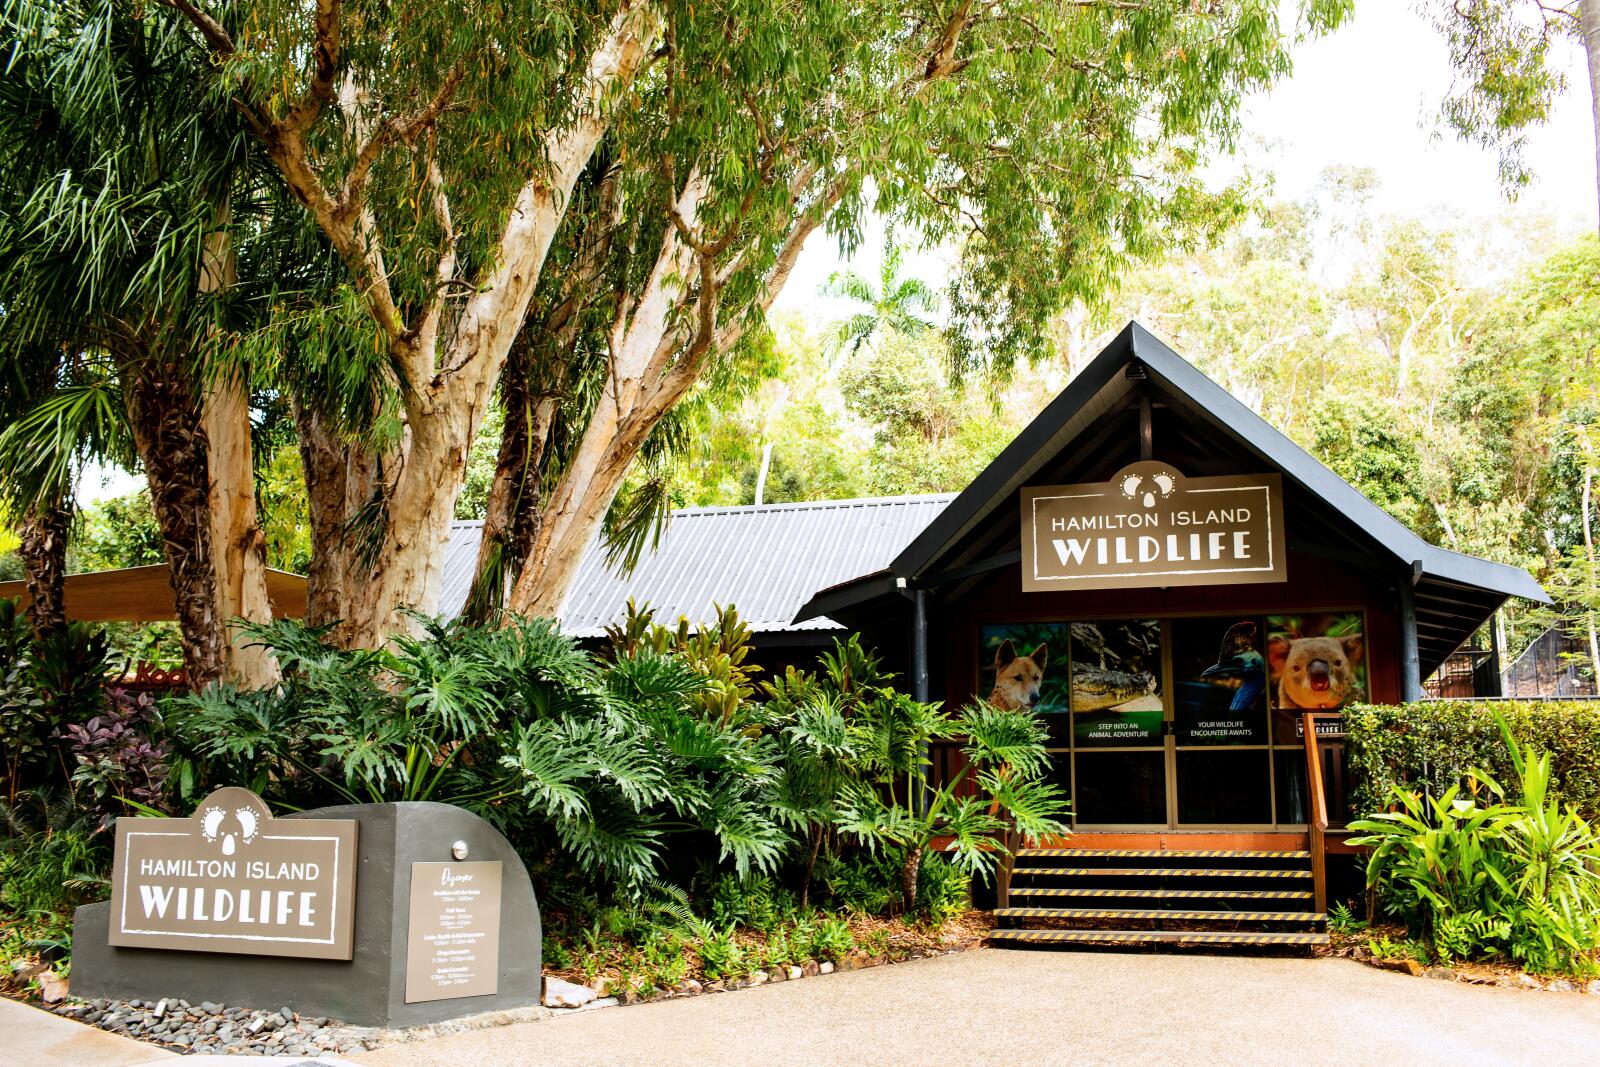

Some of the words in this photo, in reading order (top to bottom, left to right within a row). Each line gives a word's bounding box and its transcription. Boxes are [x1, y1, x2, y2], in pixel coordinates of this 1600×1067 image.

[1052, 513, 1159, 532] HAMILTON
[1171, 508, 1251, 526] ISLAND
[1052, 531, 1251, 567] WILDLIFE
[1216, 720, 1244, 728] WILDLIFE
[1298, 726, 1339, 734] WDLIFE
[1112, 730, 1149, 738] ADVENTURE
[1190, 729, 1228, 737] ENCOUNTER
[140, 859, 236, 878] HAMILTON
[246, 861, 320, 881] ISLAND
[139, 884, 317, 927] WILDLIFE
